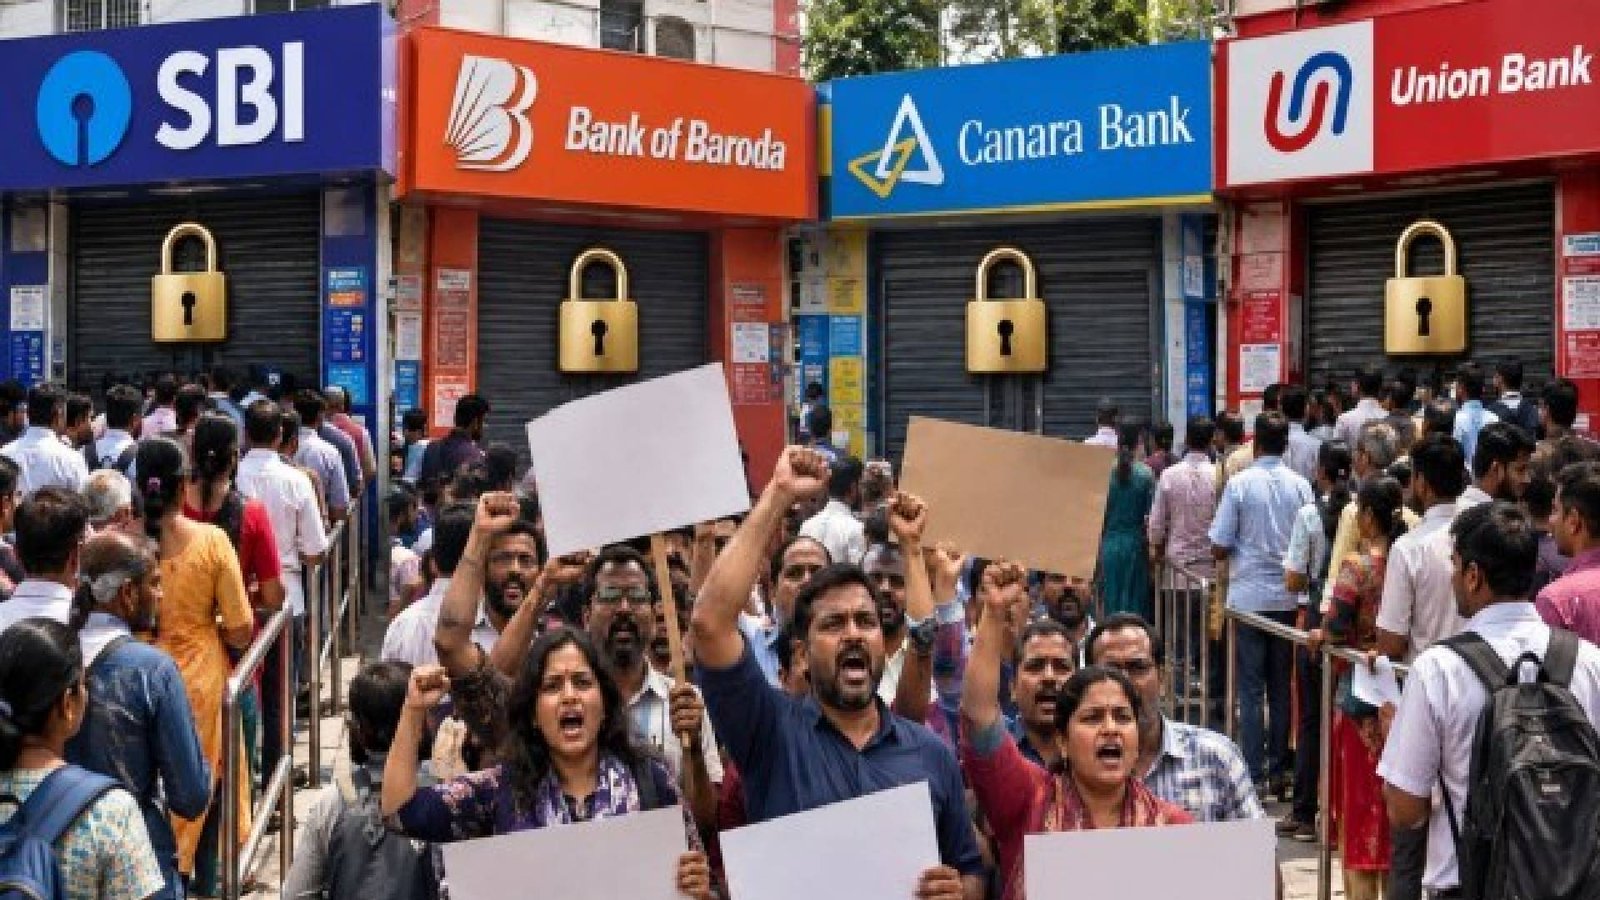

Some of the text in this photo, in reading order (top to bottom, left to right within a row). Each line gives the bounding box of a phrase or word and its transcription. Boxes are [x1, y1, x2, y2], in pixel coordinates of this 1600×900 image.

[154, 40, 305, 149] SBI
[1390, 44, 1593, 106] Union Bank
[564, 105, 787, 171] Bank of Baroda
[958, 94, 1194, 167] Canara Bank
